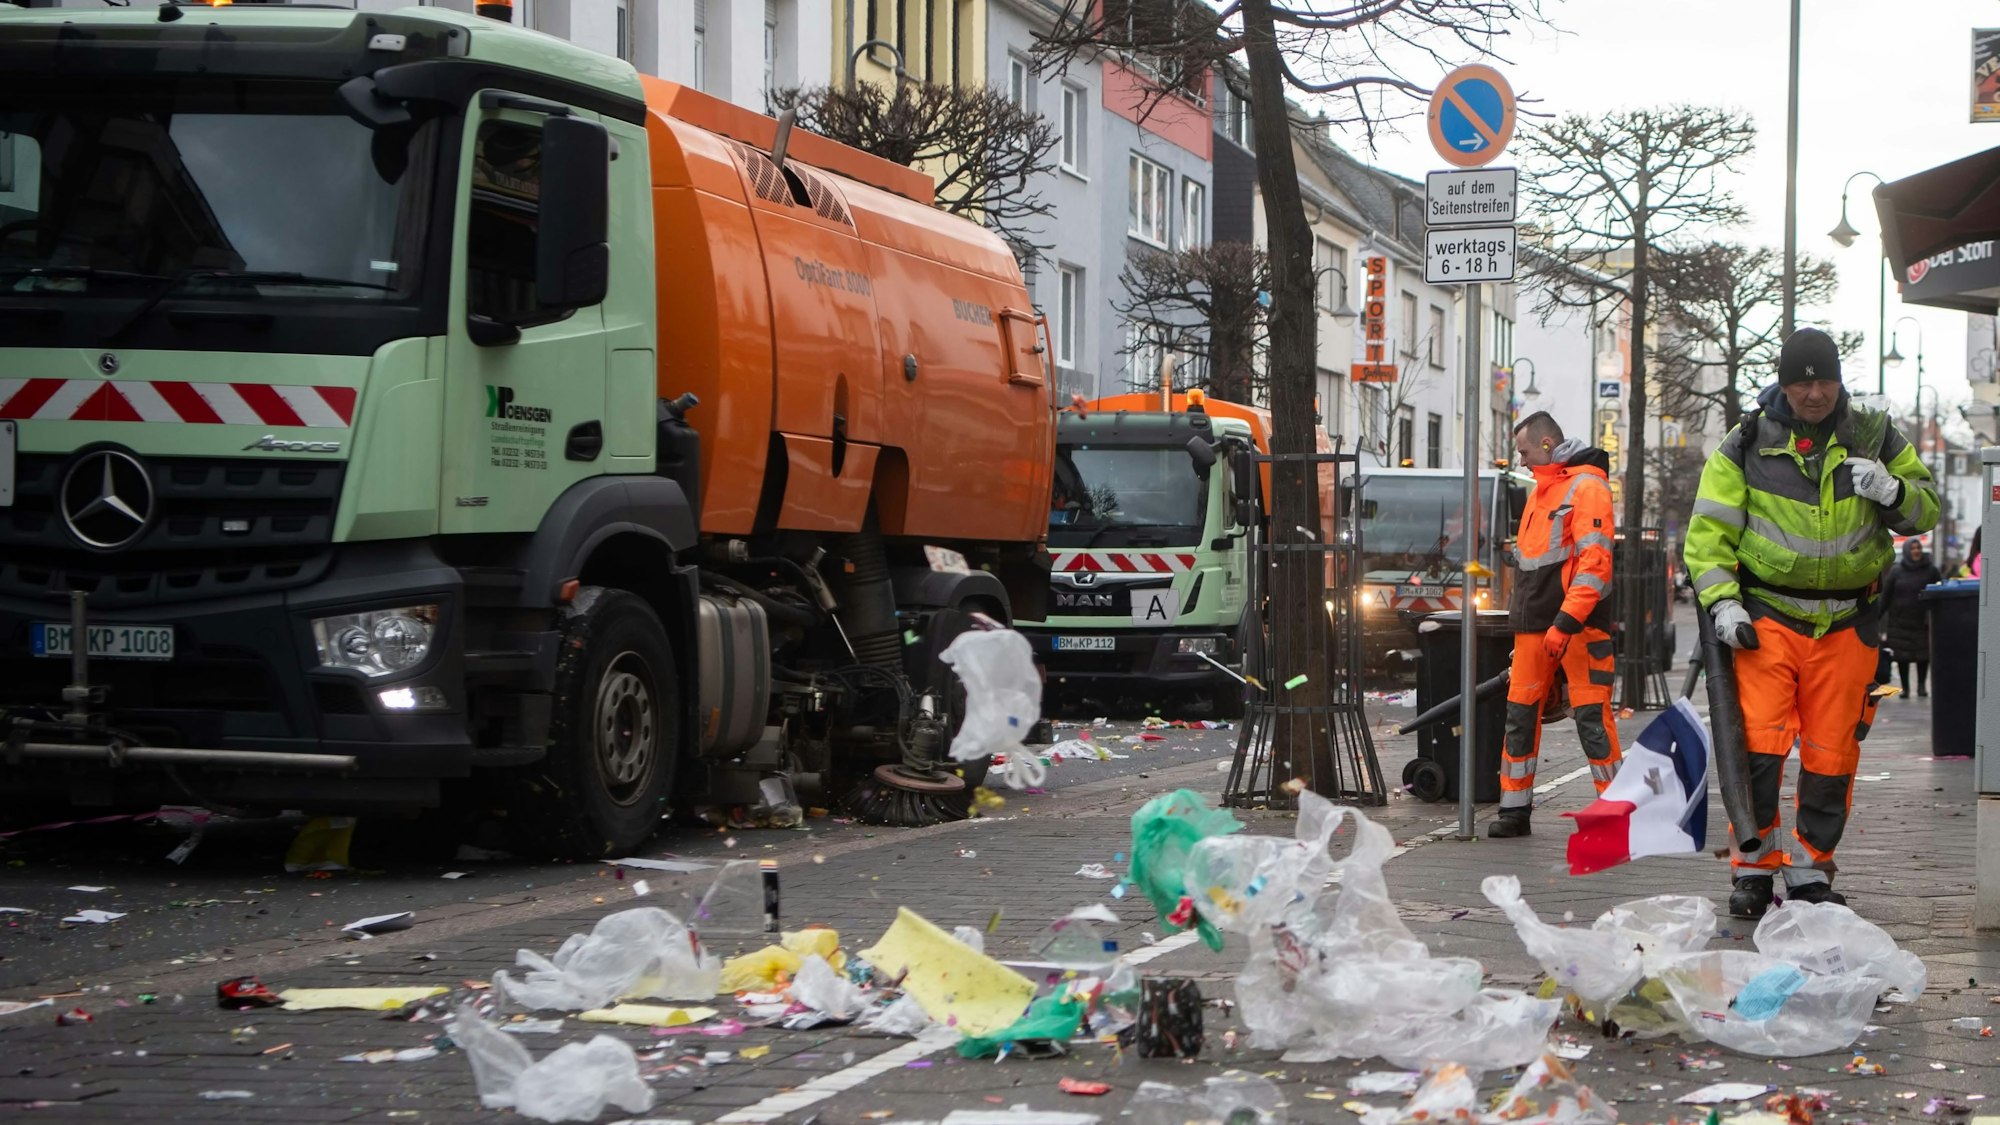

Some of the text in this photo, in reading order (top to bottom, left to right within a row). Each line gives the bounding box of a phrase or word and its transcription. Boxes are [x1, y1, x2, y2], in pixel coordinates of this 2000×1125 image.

[1447, 180, 1495, 195] auf dem
[1432, 199, 1510, 215] Seitenstreifen
[1435, 239, 1506, 257] werktags
[1441, 259, 1450, 275] 6
[1465, 258, 1482, 273] 18
[1488, 257, 1497, 272] h
[846, 271, 871, 297] 8000
[951, 298, 994, 327] BUCHER
[1370, 258, 1384, 361] SPORT
[491, 422, 545, 436] Straßenreinigung
[1056, 594, 1112, 606] MAN
[1146, 595, 1167, 620] A
[47, 627, 170, 653] BM KP 1008
[1059, 638, 1114, 649] BM KP 112
